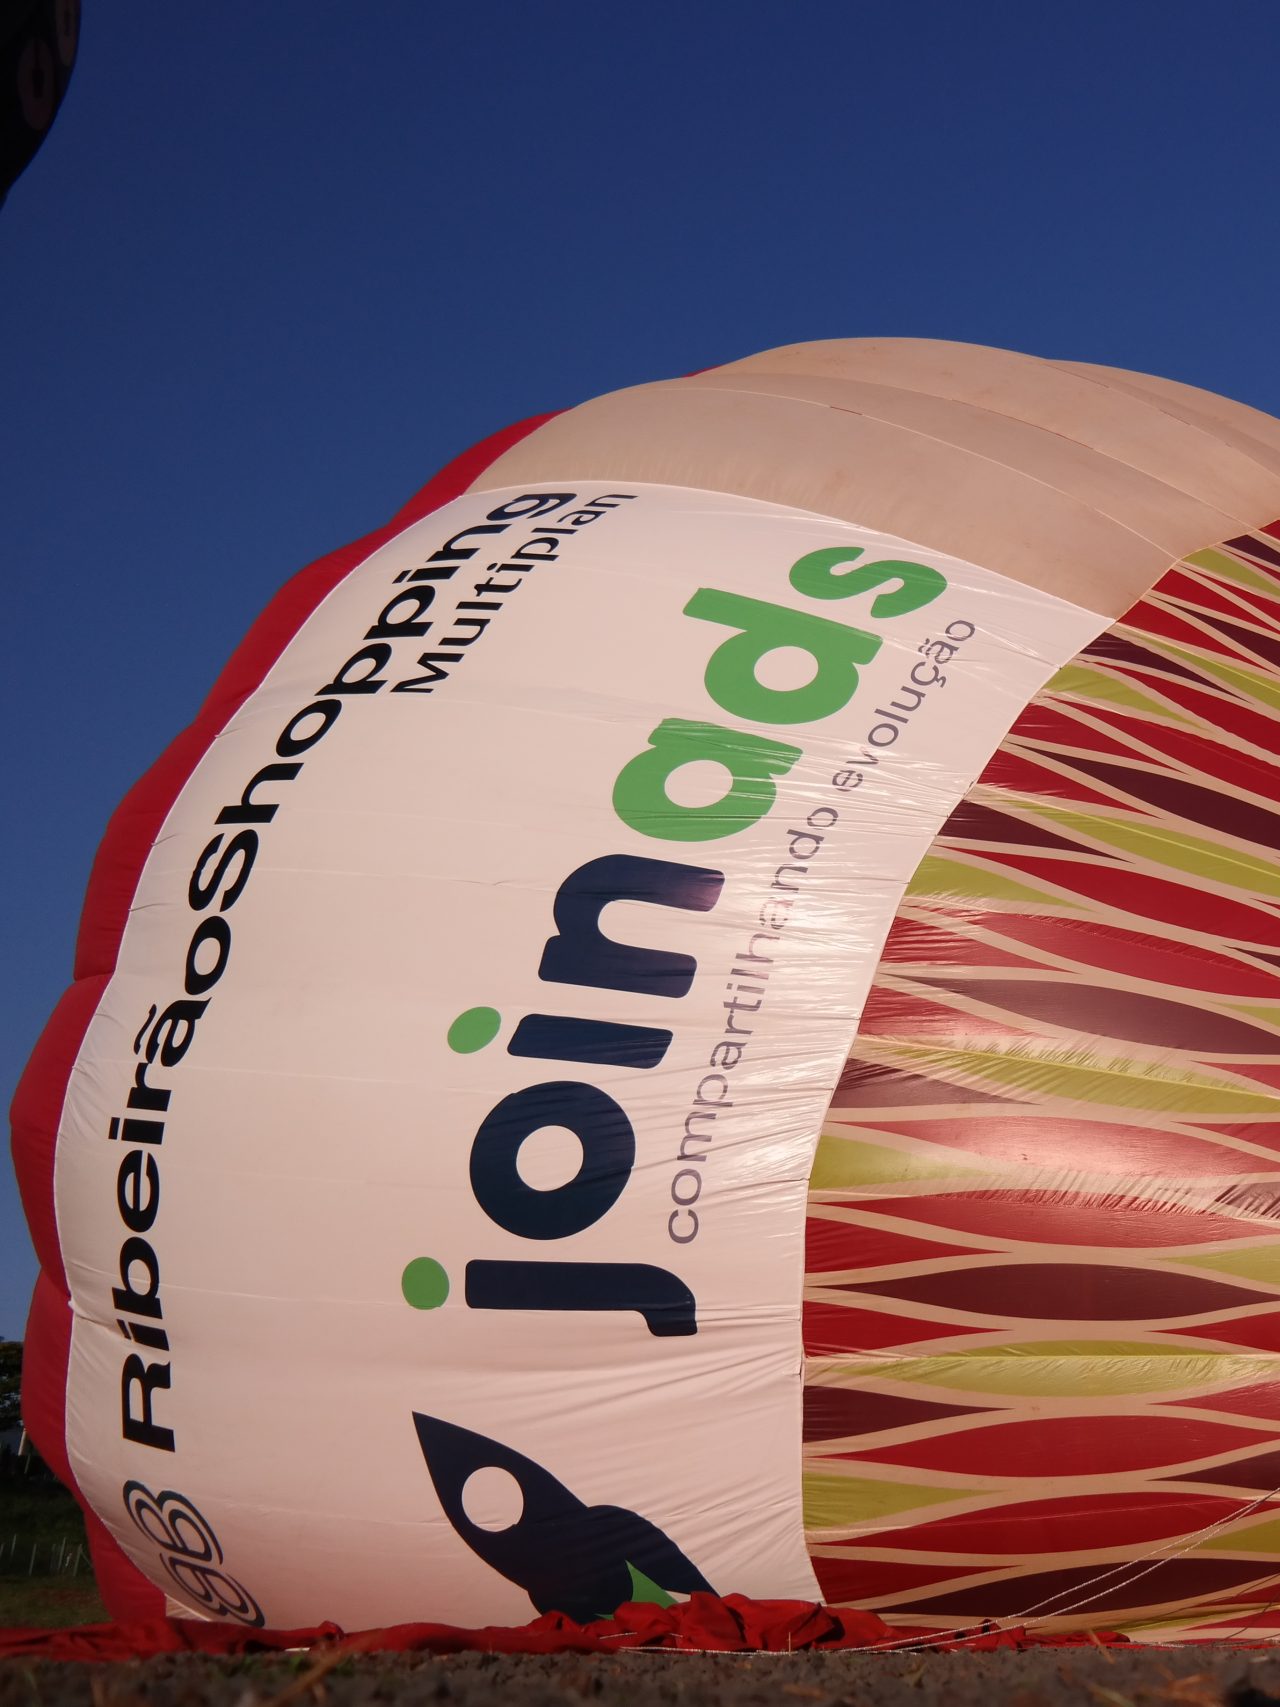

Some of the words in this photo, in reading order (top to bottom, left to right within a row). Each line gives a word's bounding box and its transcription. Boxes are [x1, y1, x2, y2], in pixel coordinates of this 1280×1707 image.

[390, 493, 639, 694] Multiplan
[401, 546, 948, 1338] joinads
[668, 806, 839, 1245] compartilhando
[831, 619, 976, 792] evolução
